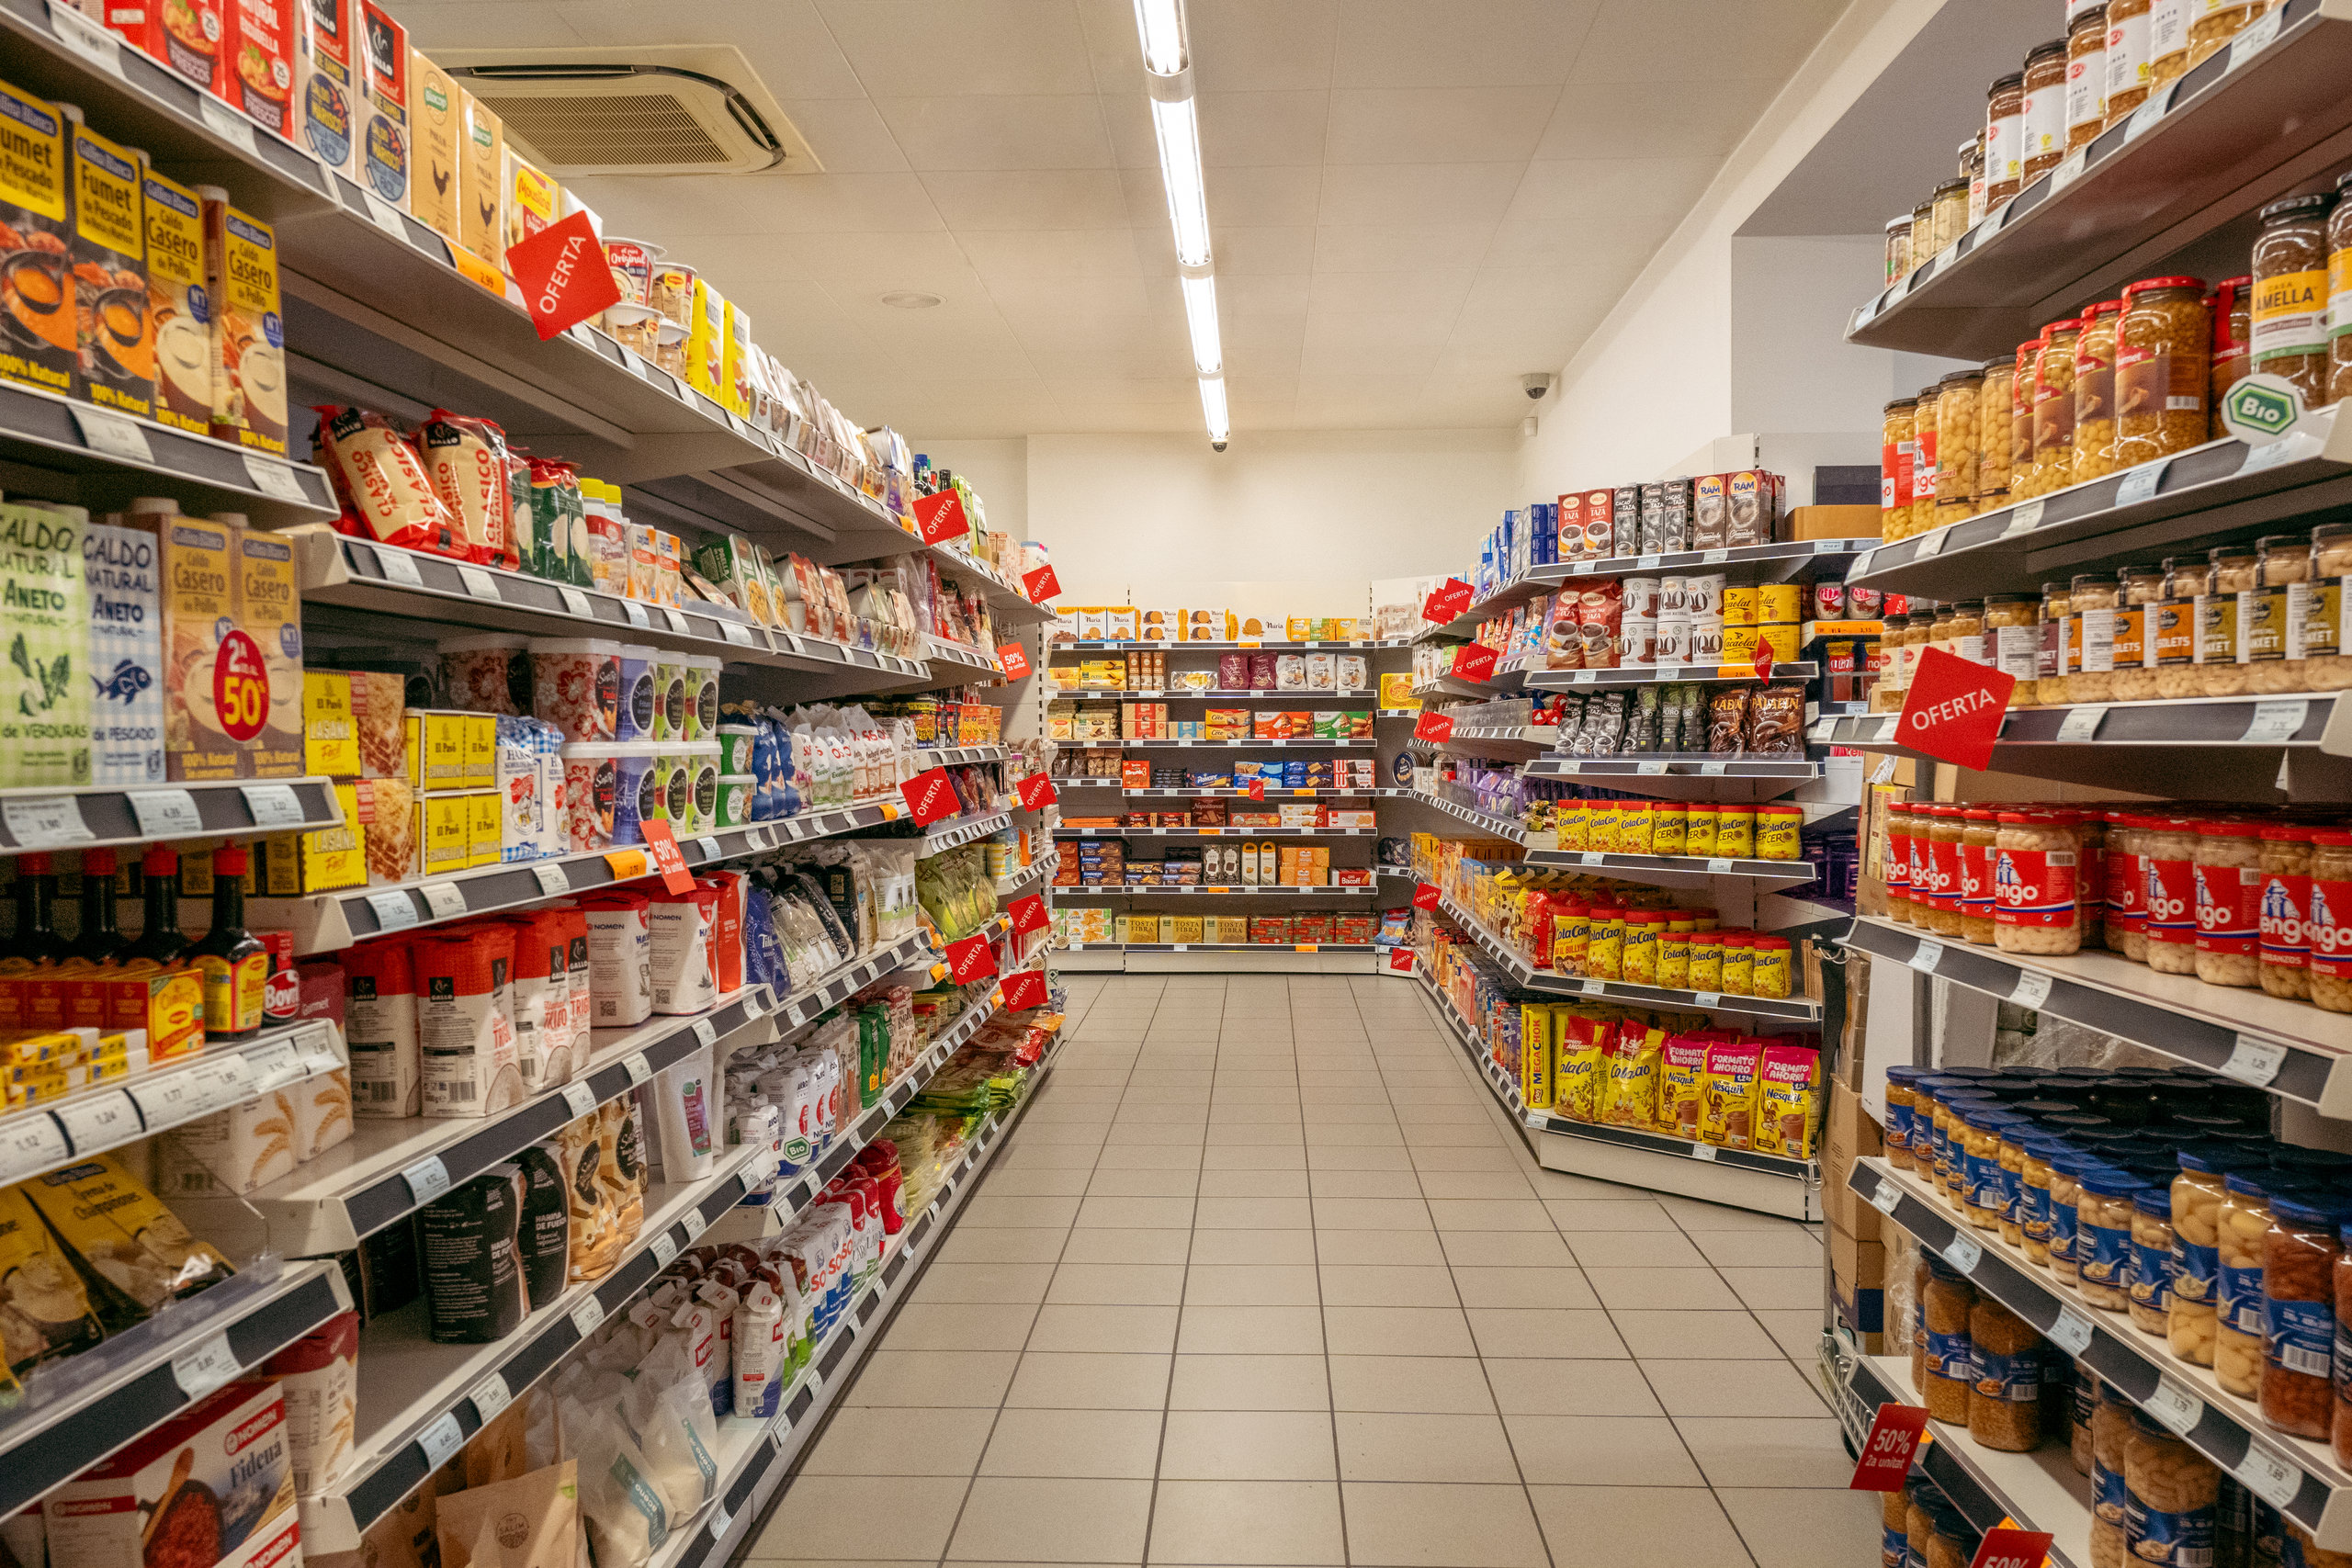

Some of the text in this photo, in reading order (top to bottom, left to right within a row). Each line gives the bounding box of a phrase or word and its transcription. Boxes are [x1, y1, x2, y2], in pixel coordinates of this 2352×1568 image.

[0, 126, 53, 169] umet
[82, 164, 133, 212] Fumet
[147, 217, 198, 261] Casero
[229, 250, 272, 290] Casero
[539, 235, 586, 314] OFERTA
[384, 430, 435, 518] CLASICO
[1701, 485, 1720, 495] RAM
[1734, 481, 1755, 491] RAM
[927, 499, 956, 536] OFERTA
[1590, 508, 1606, 516] TAZA
[83, 536, 151, 569] CALDO
[175, 562, 226, 593] Casero
[1033, 572, 1052, 598] OFERTA
[4, 579, 66, 611] ANETO
[245, 574, 290, 603] Casero
[1444, 589, 1469, 602] OFERTA
[93, 593, 144, 624] ANETO
[1004, 652, 1023, 664] 50%
[1466, 654, 1493, 669] OFERTA
[1751, 696, 1800, 710] PALADIN
[1912, 689, 1996, 730] OFERTA
[1427, 722, 1450, 734] OFERTA
[917, 778, 944, 817] OFERTA
[1026, 780, 1046, 807] OFERTA
[1559, 815, 1586, 827] ColaCao
[1590, 816, 1617, 828] ColaCao
[1621, 817, 1649, 829] ColaCao
[653, 839, 679, 861] 50%
[1416, 892, 1438, 904] OFERTA
[1996, 883, 2038, 905] engo
[653, 912, 682, 922] NOMEN
[1019, 901, 1039, 929] OFERTA
[594, 922, 625, 931] NOMEN
[2260, 915, 2312, 944] engo
[958, 942, 984, 976] OFERTA
[1393, 953, 1410, 966] OFERTA
[1011, 977, 1032, 1006] OFERTA
[1712, 1055, 1755, 1066] FORMATO
[1713, 1063, 1750, 1073] AHORRO
[1768, 1061, 1809, 1072] FORMATO
[1668, 1072, 1695, 1085] Nesquik
[1770, 1070, 1805, 1082] AHORRO
[1713, 1081, 1746, 1095] Nesquik
[1767, 1089, 1803, 1103] Nesquik
[1873, 1428, 1912, 1454] 50%
[1878, 1457, 1905, 1469] unitat
